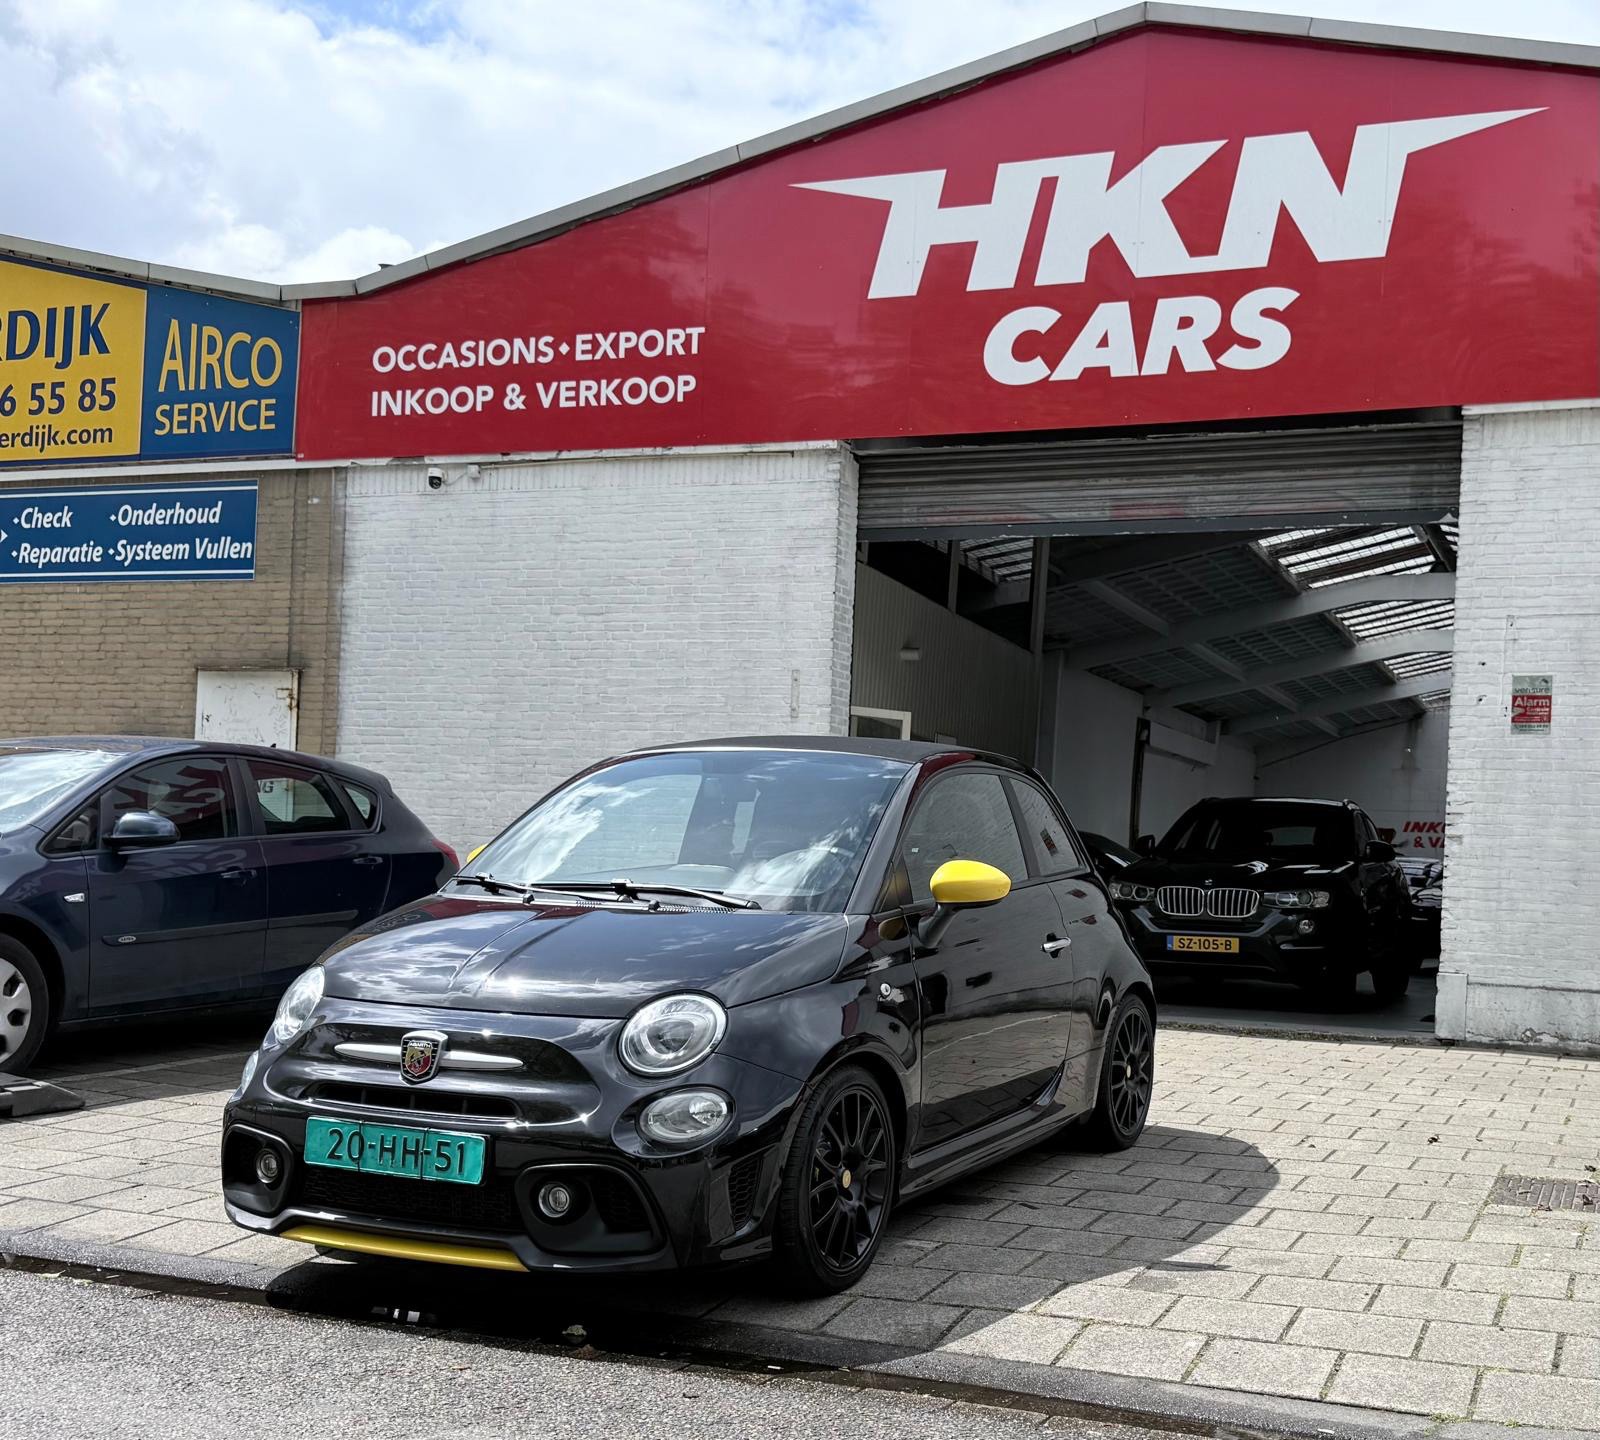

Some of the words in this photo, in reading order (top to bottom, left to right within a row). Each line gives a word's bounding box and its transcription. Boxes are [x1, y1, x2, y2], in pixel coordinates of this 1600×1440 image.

[789, 107, 1549, 299] HKN
[0, 303, 111, 369] DIJK
[158, 318, 282, 393] AIRCO
[372, 335, 554, 373] OCCASIONS
[575, 327, 705, 361] EXPORT
[983, 287, 1300, 386] CARS
[28, 381, 65, 416] 55
[78, 377, 117, 412] 85
[371, 386, 494, 416] INKOOP
[503, 383, 526, 411] &
[536, 375, 696, 409] VERKOOP
[154, 398, 276, 436] SERVICE
[20, 505, 74, 529] Check
[117, 501, 222, 527] Onderhoud
[18, 540, 103, 569] Reparatie
[115, 538, 190, 567] Systeem
[195, 536, 253, 560] Vullen
[1514, 696, 1550, 707] Alarm
[1413, 836, 1425, 848] &
[1178, 937, 1232, 951] SZ-105-B
[325, 1127, 466, 1176] 20-HH-51
